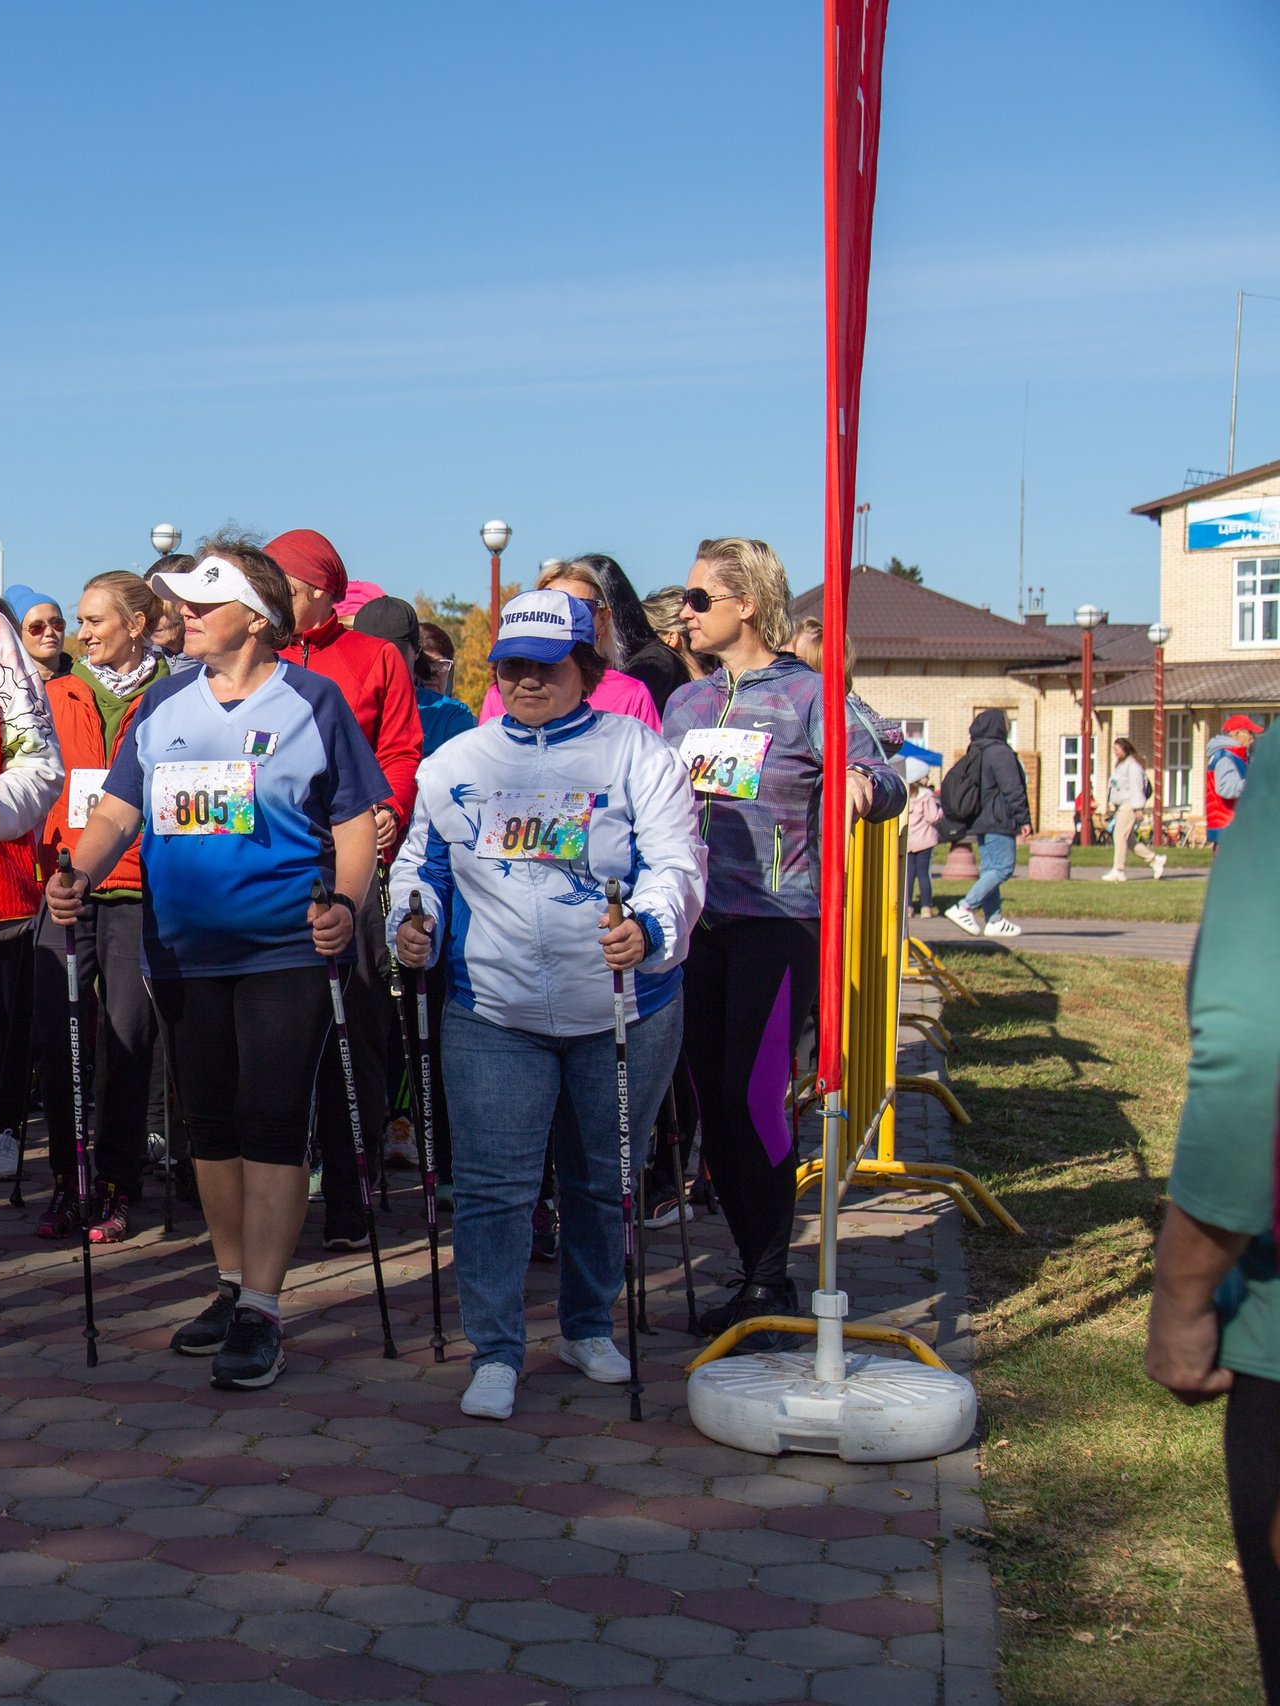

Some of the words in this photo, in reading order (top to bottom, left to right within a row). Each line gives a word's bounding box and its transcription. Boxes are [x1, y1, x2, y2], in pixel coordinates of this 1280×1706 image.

[690, 754, 738, 788] 843
[175, 790, 229, 826] 805
[503, 817, 559, 851] 804
[69, 1016, 81, 1085] СЕВЕРНАЯ
[338, 1038, 357, 1100] СЕВЕРНАЯ
[420, 1054, 433, 1117] СЕВЕРНАЯ
[616, 1061, 630, 1132] СЕВЕРНАЯ
